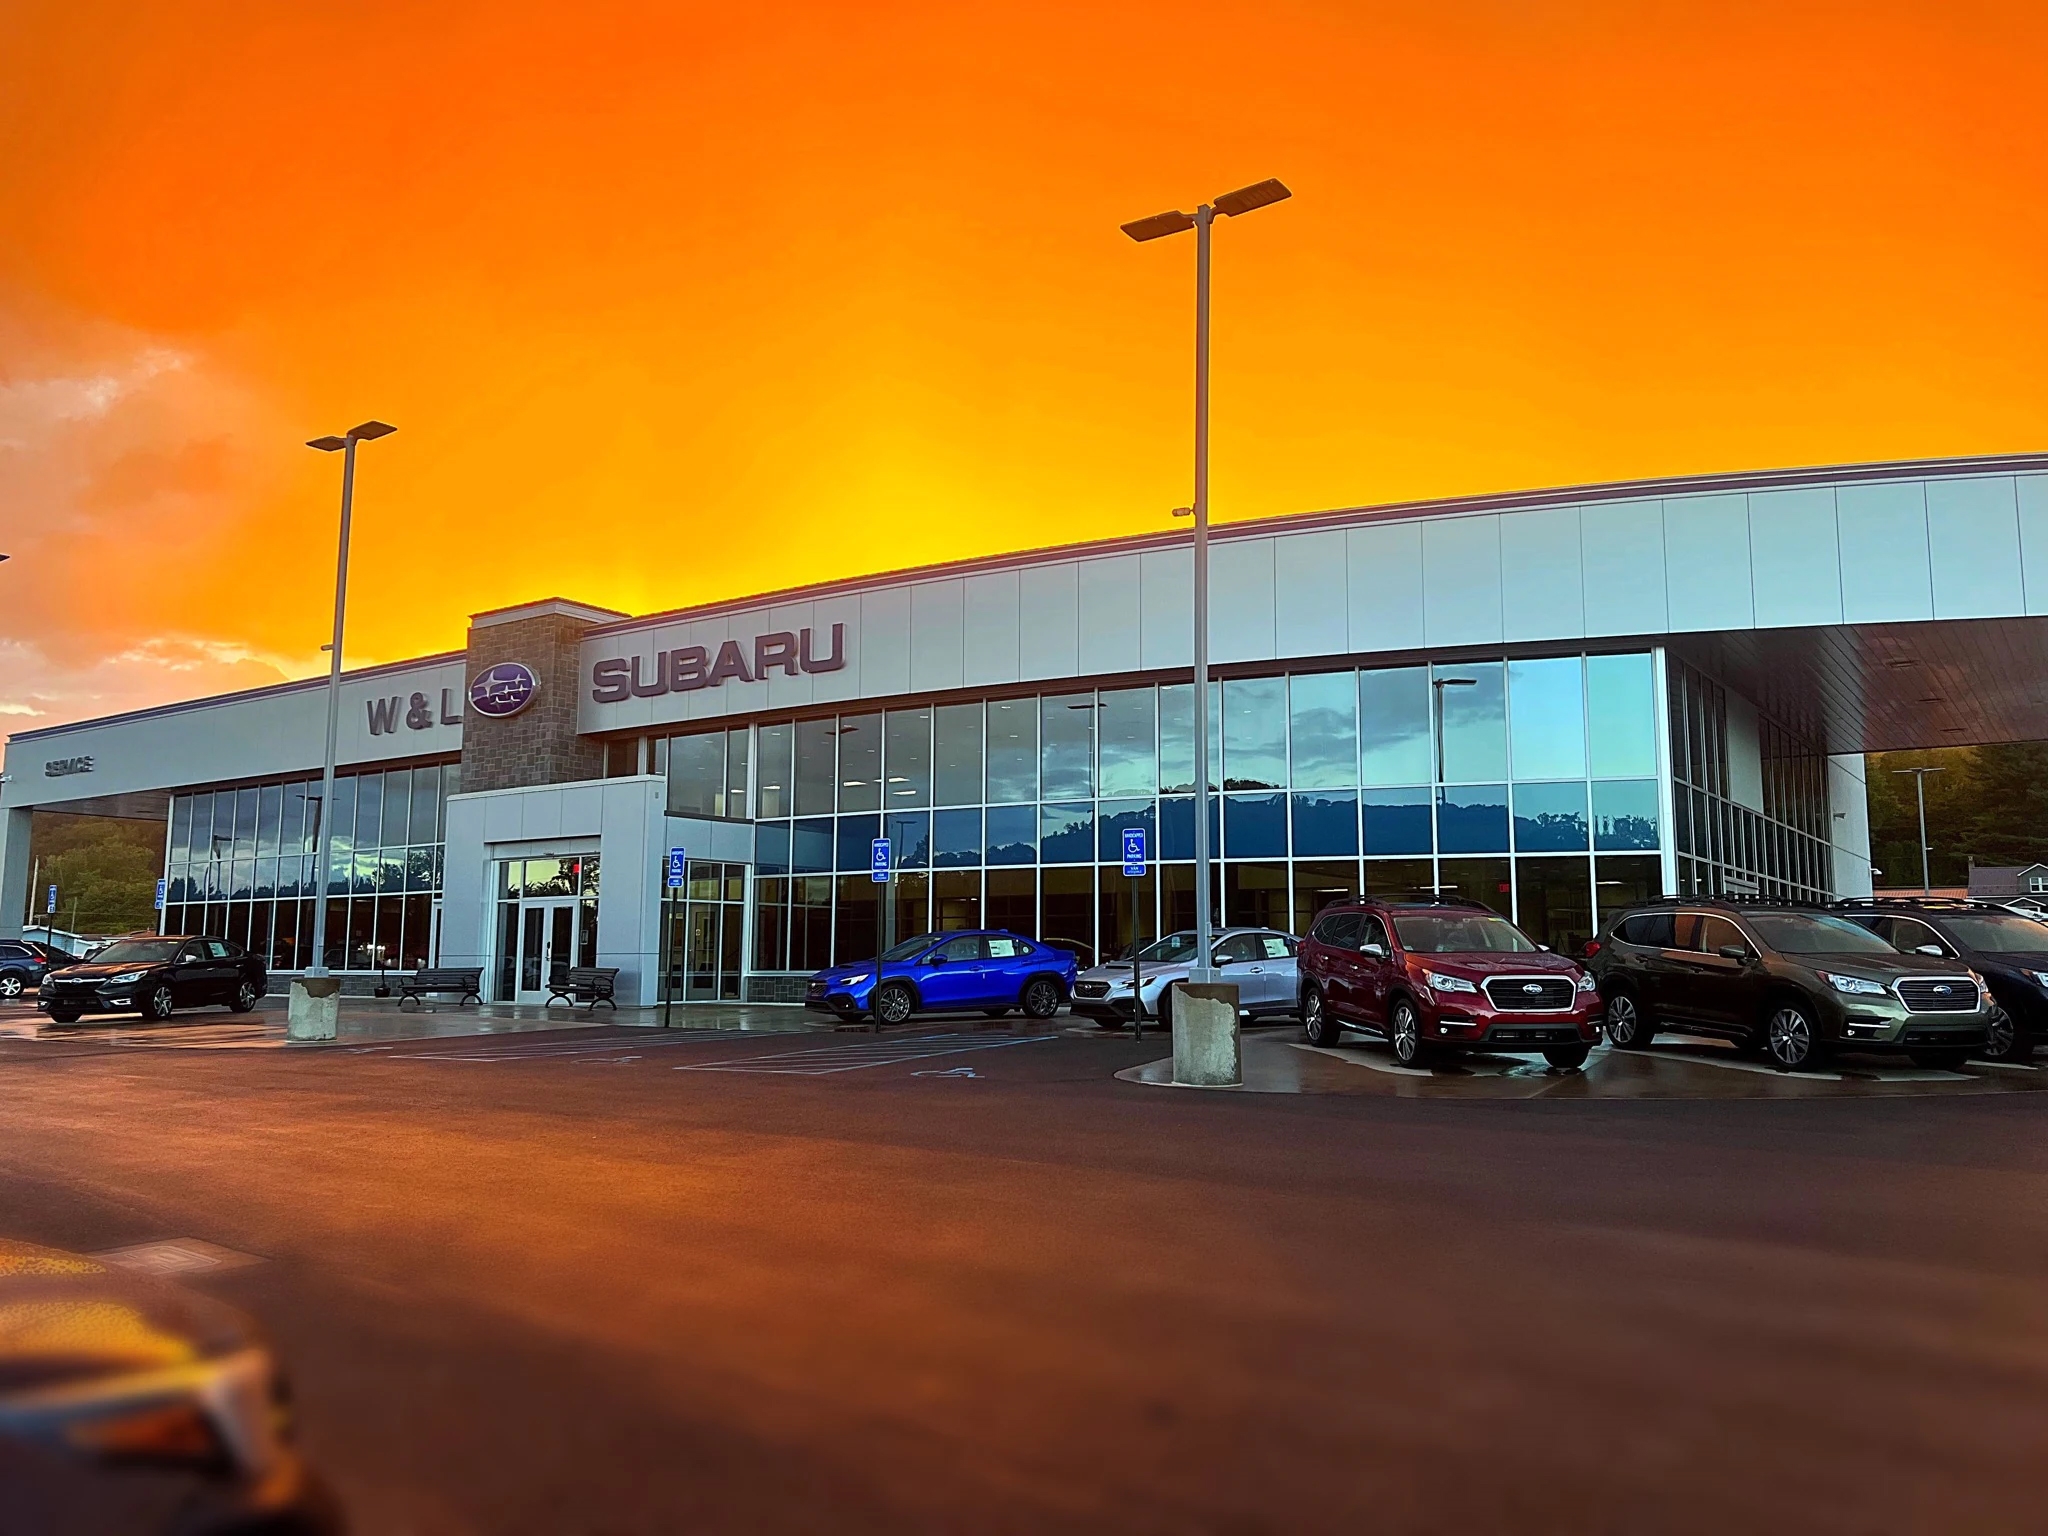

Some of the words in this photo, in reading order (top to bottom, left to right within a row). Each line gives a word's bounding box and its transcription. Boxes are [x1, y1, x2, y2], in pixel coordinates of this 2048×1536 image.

[592, 622, 846, 703] SUBARU
[366, 696, 402, 736] W
[406, 691, 433, 730] &
[440, 688, 463, 725] L
[45, 755, 95, 777] SERVICE
